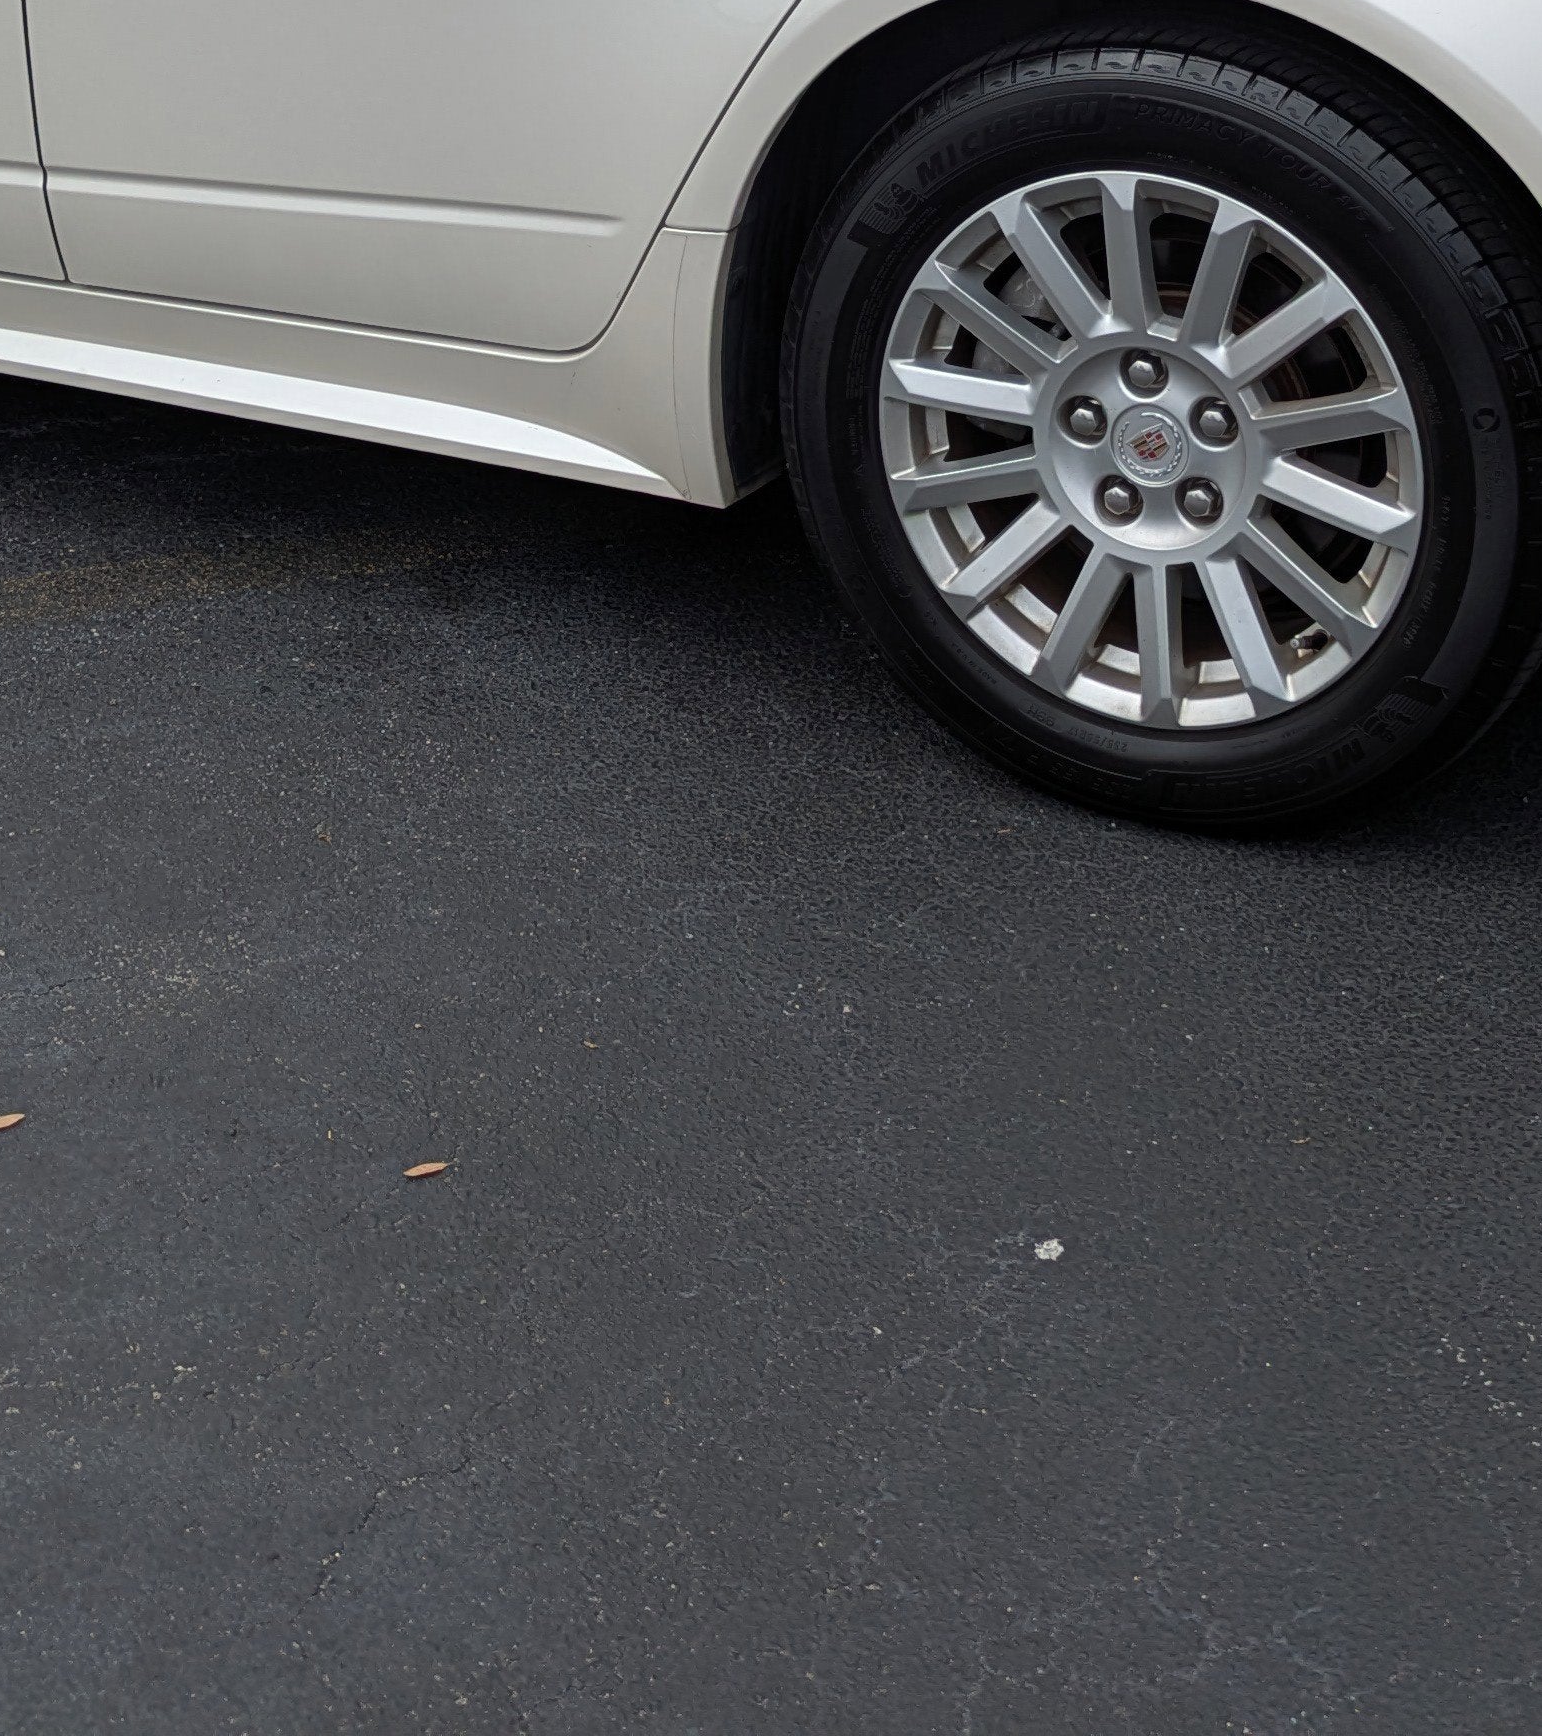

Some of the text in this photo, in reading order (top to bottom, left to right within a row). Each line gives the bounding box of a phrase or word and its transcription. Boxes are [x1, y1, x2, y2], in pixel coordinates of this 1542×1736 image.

[915, 100, 1101, 188] MICHELIN
[1134, 102, 1255, 145] PRIMACY
[1262, 142, 1333, 191] TOUR
